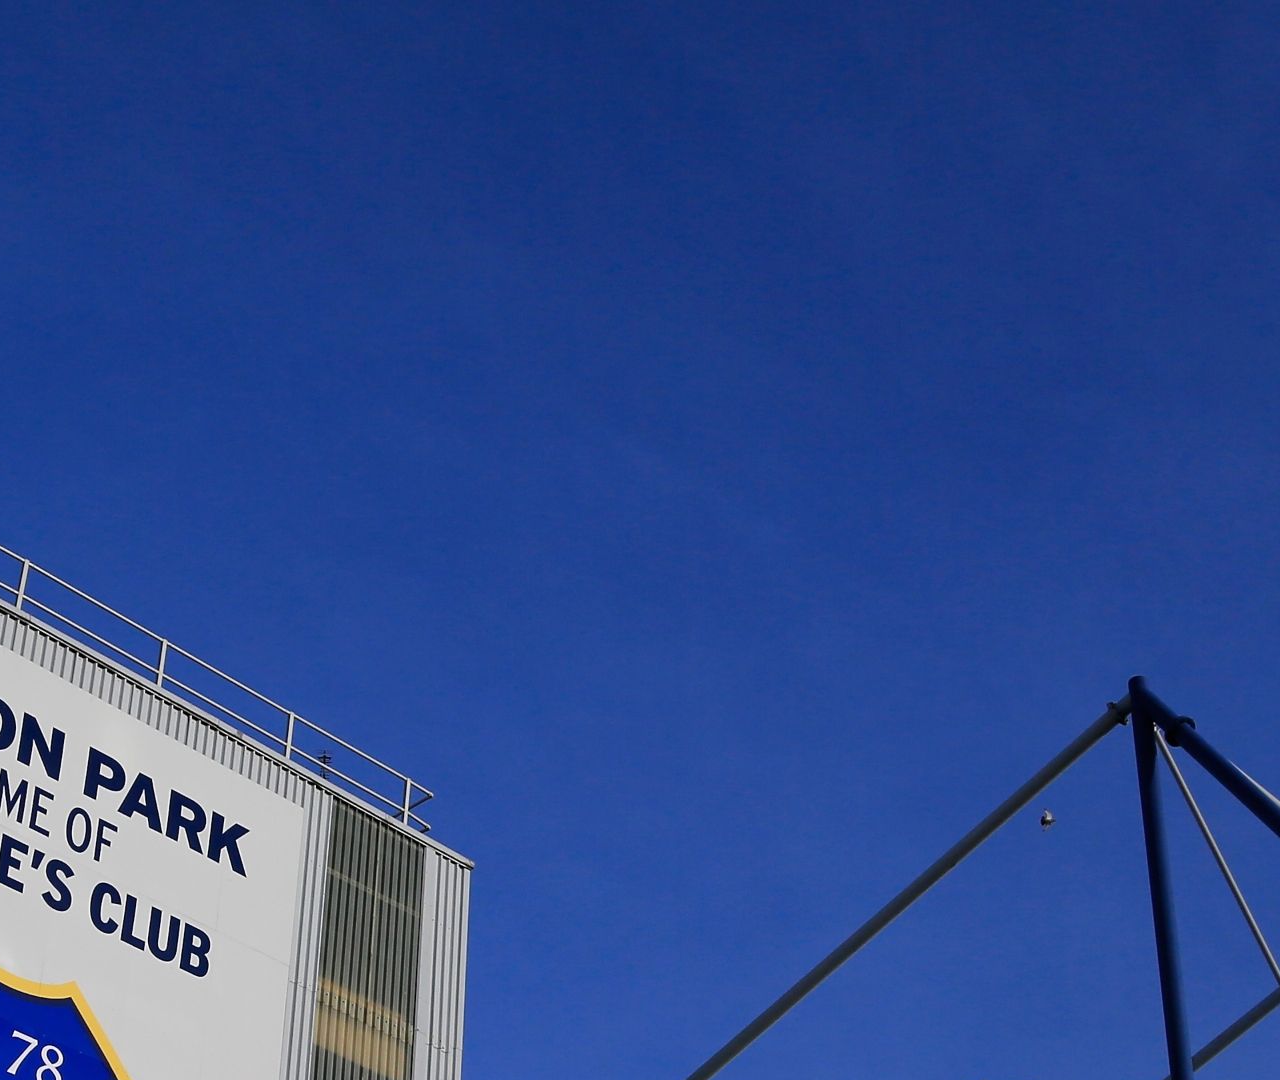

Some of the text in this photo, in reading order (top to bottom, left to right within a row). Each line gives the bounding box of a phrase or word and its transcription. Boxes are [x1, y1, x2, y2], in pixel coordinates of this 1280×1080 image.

[65, 806, 120, 863] OF
[82, 746, 251, 878] PARK
[88, 881, 213, 979] CLUB
